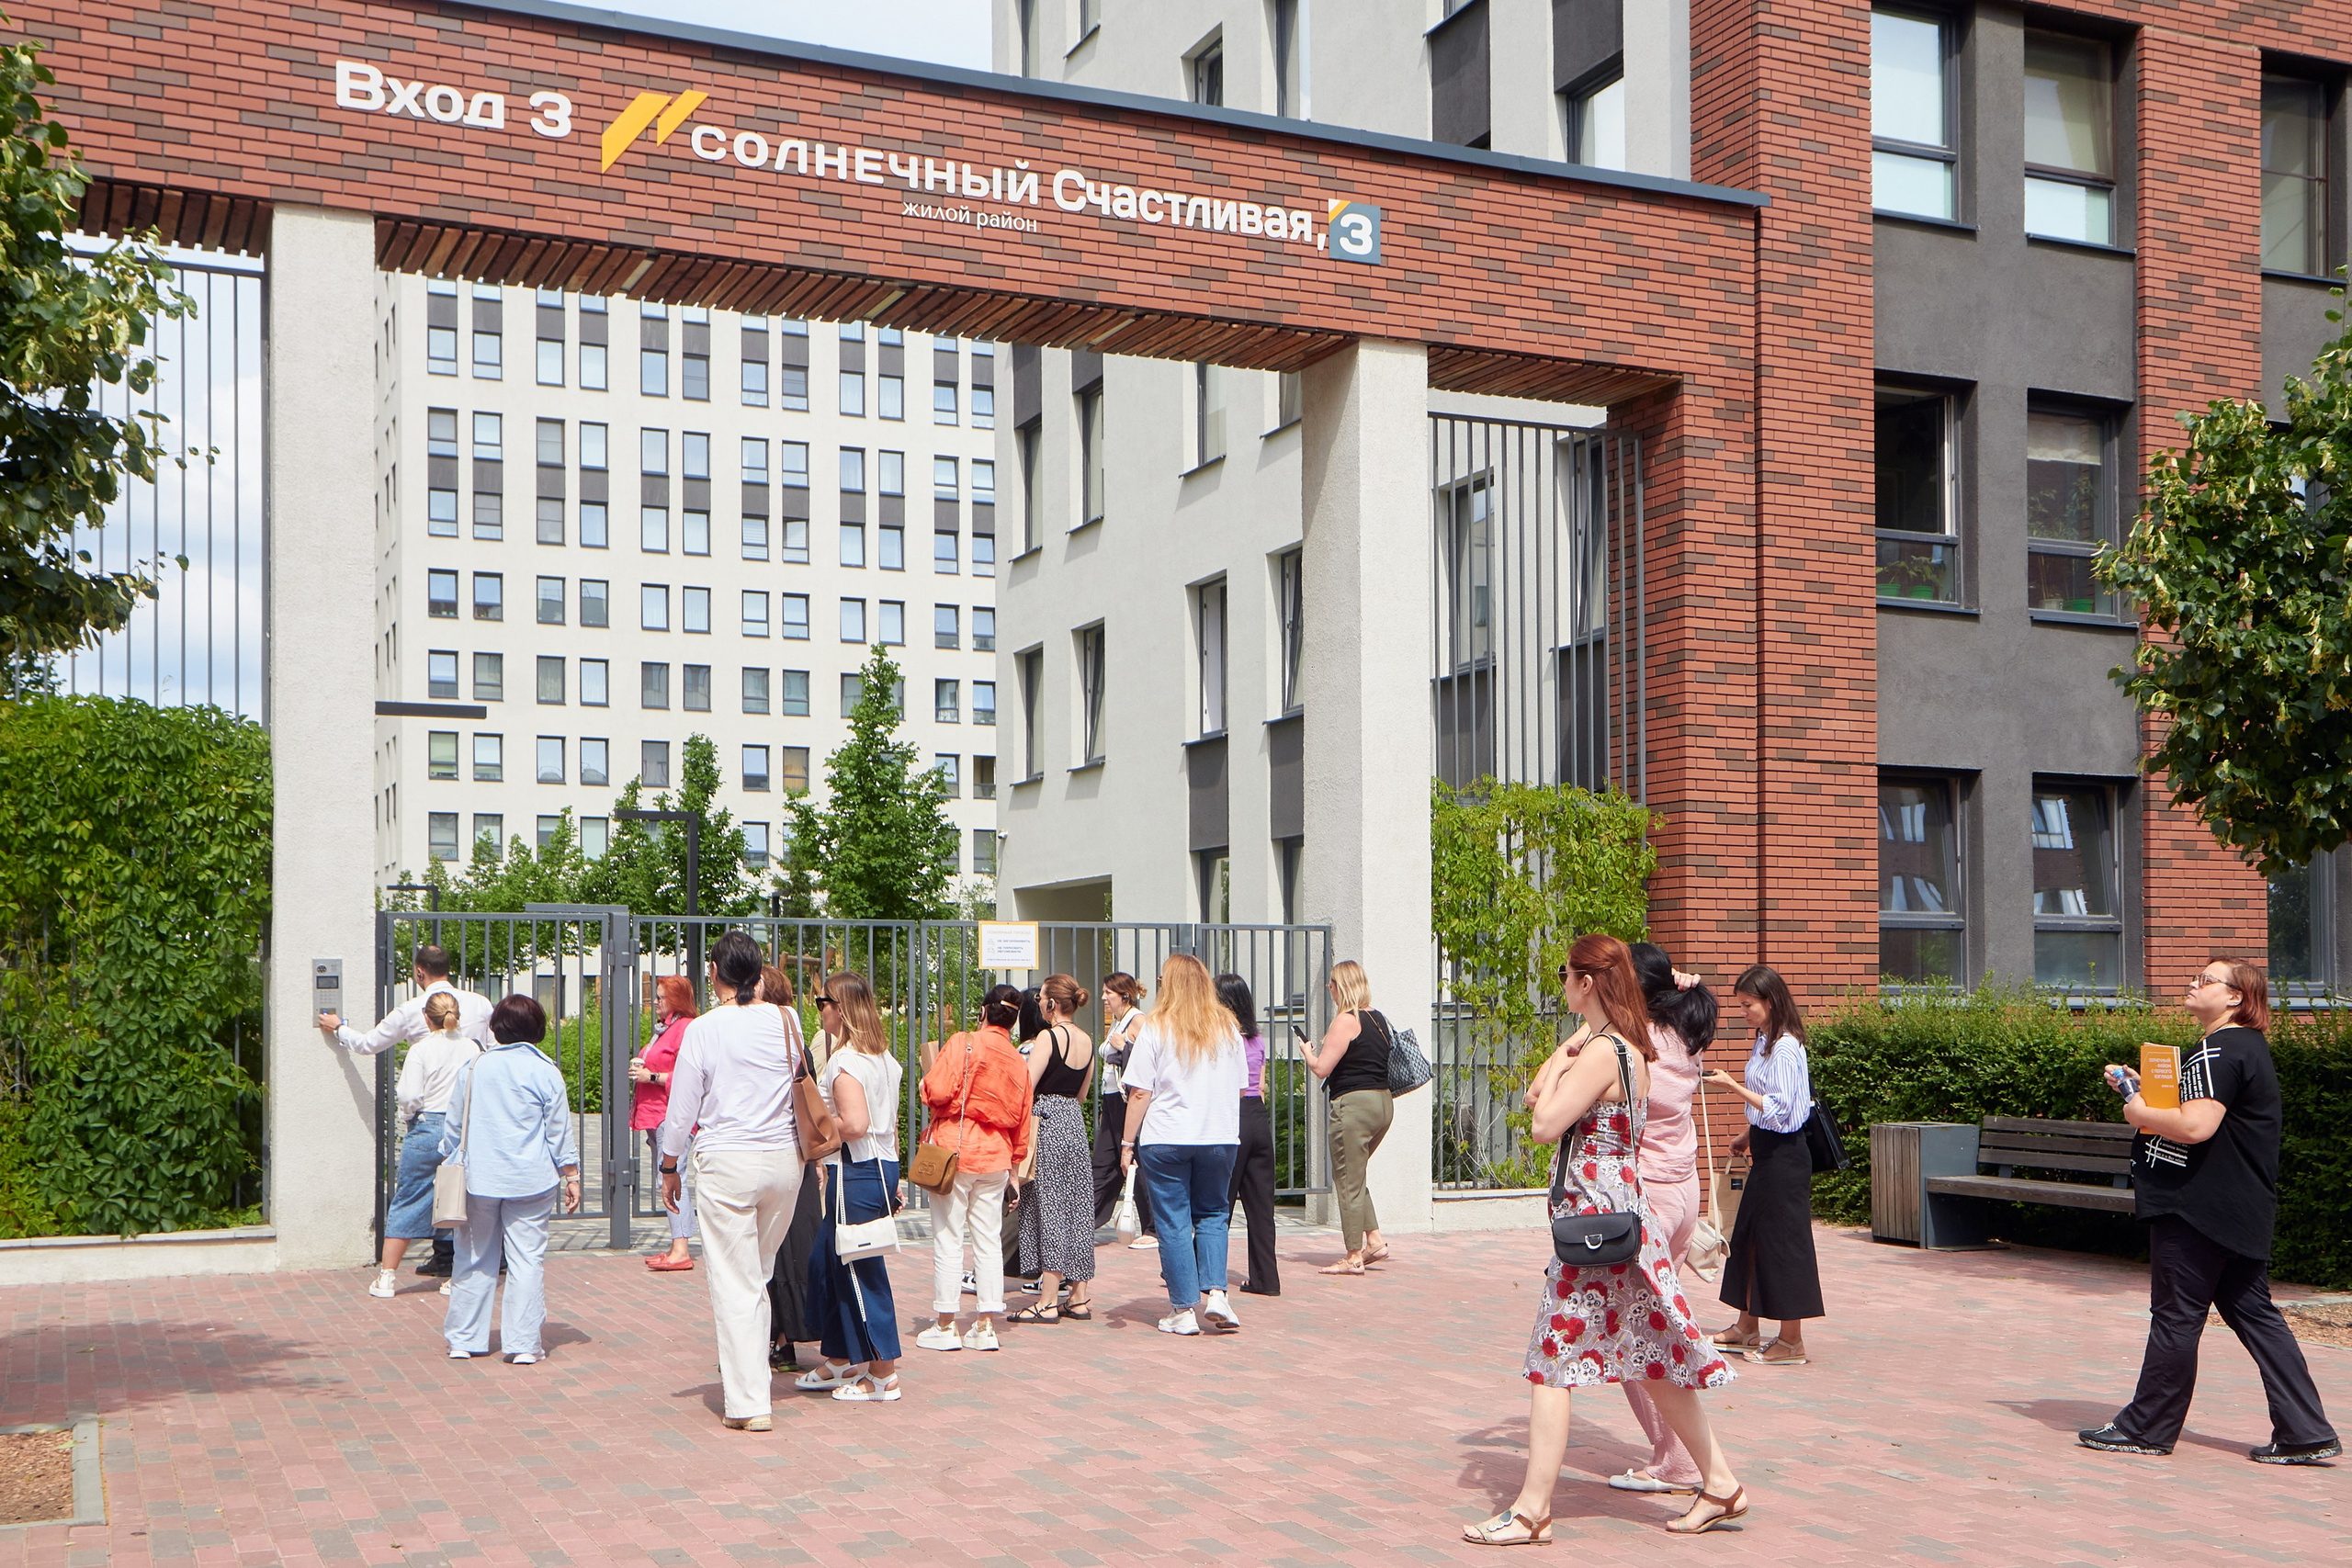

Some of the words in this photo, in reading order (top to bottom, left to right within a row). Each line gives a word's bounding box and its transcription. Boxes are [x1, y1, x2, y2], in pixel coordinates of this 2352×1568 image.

[335, 60, 505, 130] Вход
[529, 91, 572, 138] 3
[691, 125, 1039, 206] СОЛНЕЧНЫЙ
[901, 201, 971, 225] жилой
[977, 210, 1038, 233] район
[1052, 169, 1327, 252] Счастливая,
[1339, 213, 1374, 255] 3
